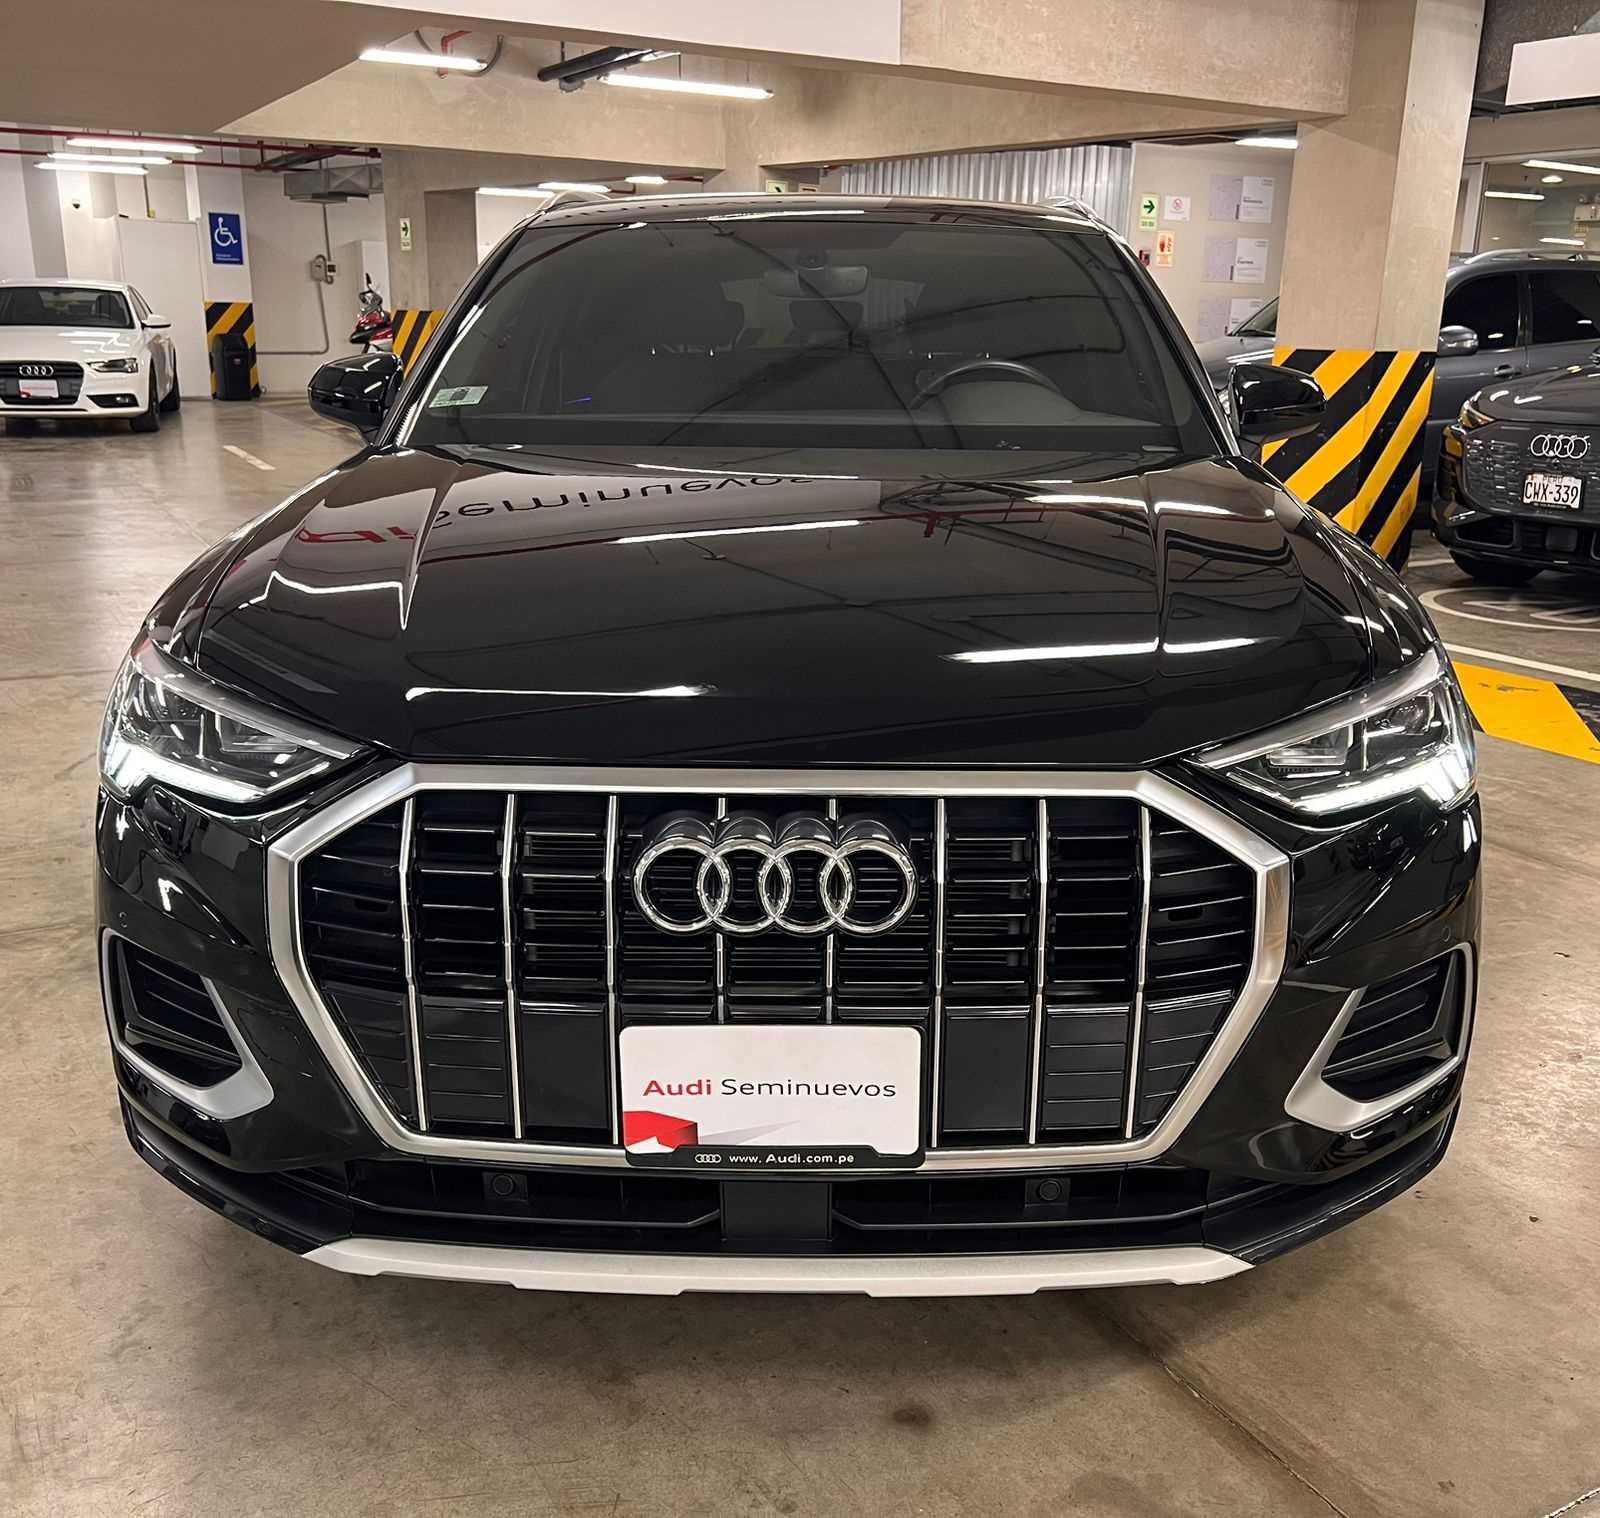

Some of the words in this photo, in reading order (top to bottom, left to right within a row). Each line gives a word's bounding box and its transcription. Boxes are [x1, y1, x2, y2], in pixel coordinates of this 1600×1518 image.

[1525, 481, 1579, 504] CWX-339
[642, 1079, 712, 1097] Audi
[720, 1078, 897, 1098] Seminuevos
